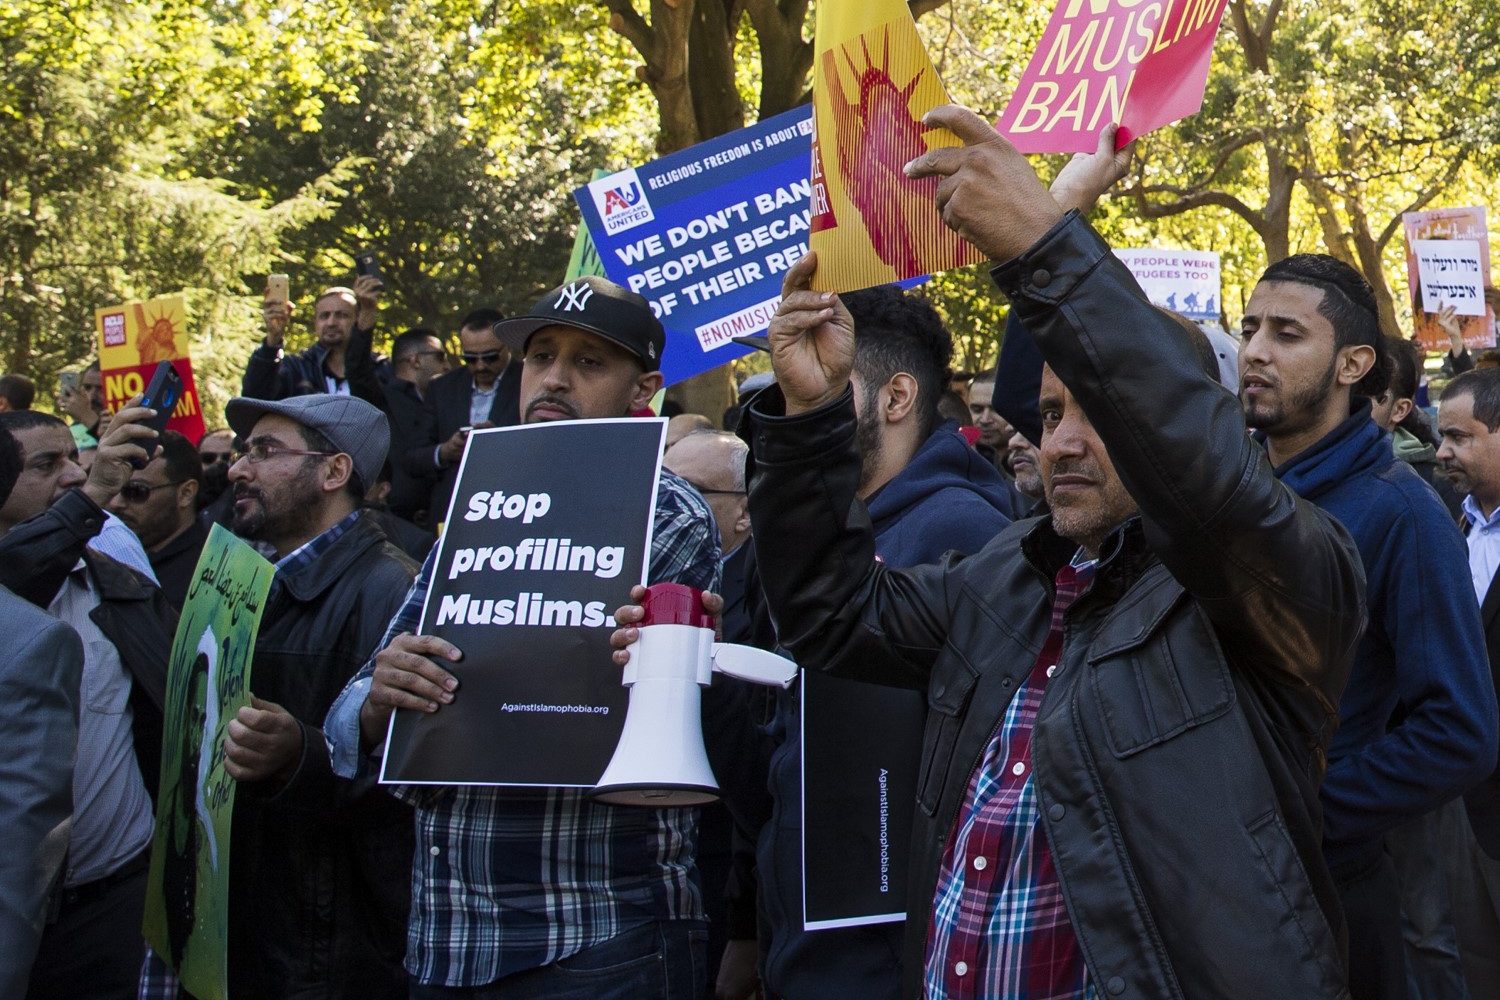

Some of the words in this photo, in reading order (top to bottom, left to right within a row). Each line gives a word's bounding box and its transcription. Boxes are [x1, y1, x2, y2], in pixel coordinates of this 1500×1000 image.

[1009, 69, 1136, 134] BAN
[648, 161, 703, 190] RELIGIOUS
[703, 143, 751, 170] FREEDOM
[753, 138, 764, 152] IS
[765, 125, 798, 148] ABOUT
[607, 205, 646, 222] AMERICANS
[608, 211, 649, 230] UNITED
[615, 234, 665, 266] WE
[667, 202, 749, 249] DON'T
[754, 178, 811, 216] BAN
[627, 241, 732, 294] PEOPLE
[1134, 258, 1178, 266] PEOPLE
[1182, 259, 1215, 268] WERE
[1135, 270, 1180, 278] FUGEES
[1184, 272, 1208, 280] TOO
[682, 263, 764, 306] THEIR
[105, 372, 144, 401] NO
[464, 490, 551, 524] Stop
[448, 538, 625, 580] profiling
[436, 592, 617, 628] Muslims.
[501, 703, 609, 714] AgainstIslamophobia.org
[879, 768, 889, 892] AgainstIslamophobia.org
